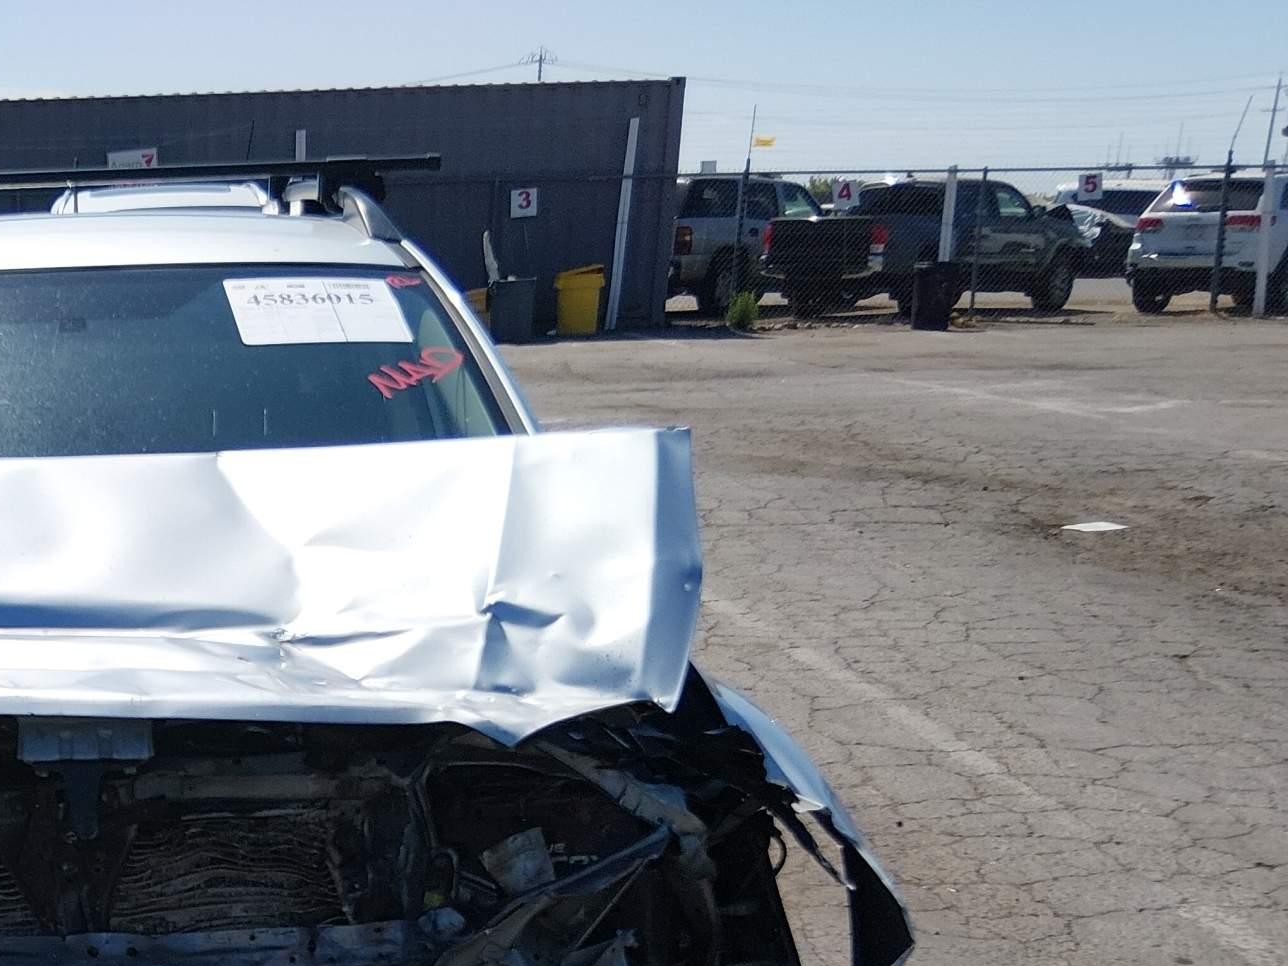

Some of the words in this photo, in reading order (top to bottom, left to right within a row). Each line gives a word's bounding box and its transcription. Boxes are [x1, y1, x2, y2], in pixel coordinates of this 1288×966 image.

[838, 183, 851, 201] 4
[1084, 175, 1097, 193] 5
[518, 190, 531, 209] 3
[247, 292, 374, 308] 45836015
